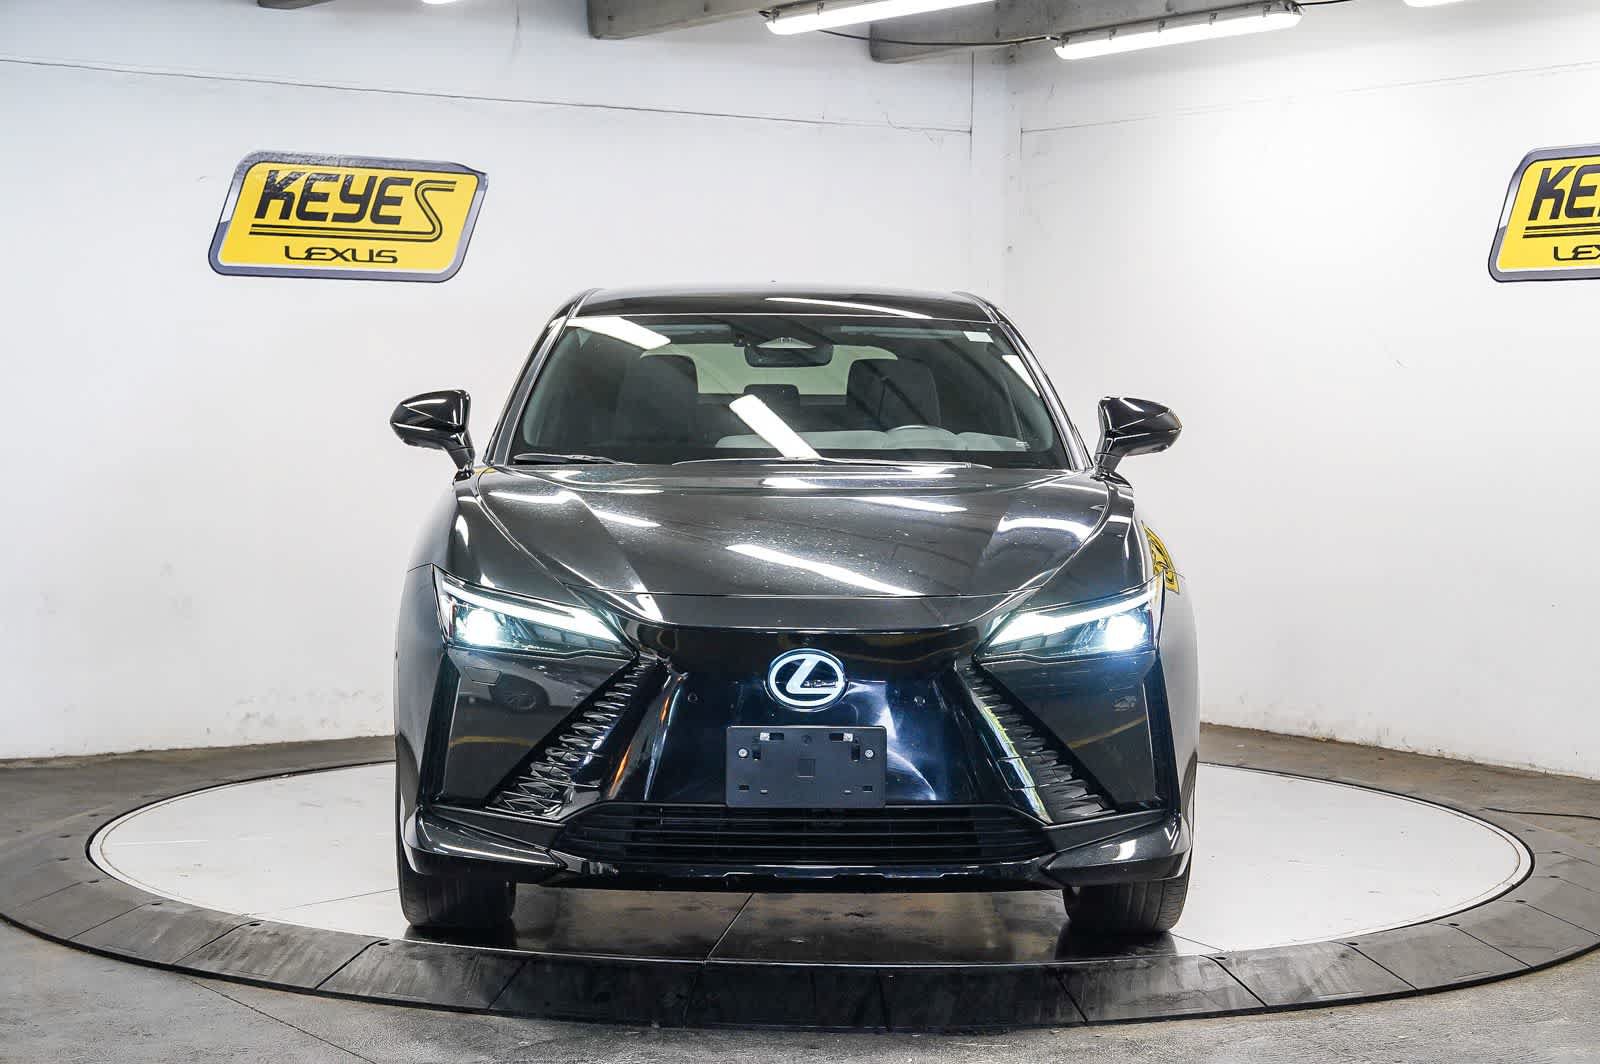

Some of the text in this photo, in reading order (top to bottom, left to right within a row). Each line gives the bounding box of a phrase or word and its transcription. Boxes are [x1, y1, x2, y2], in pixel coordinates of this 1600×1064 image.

[254, 169, 457, 242] KEYES
[1528, 164, 1600, 221] KE
[284, 245, 398, 263] LEXUS
[1553, 244, 1600, 261] LE
